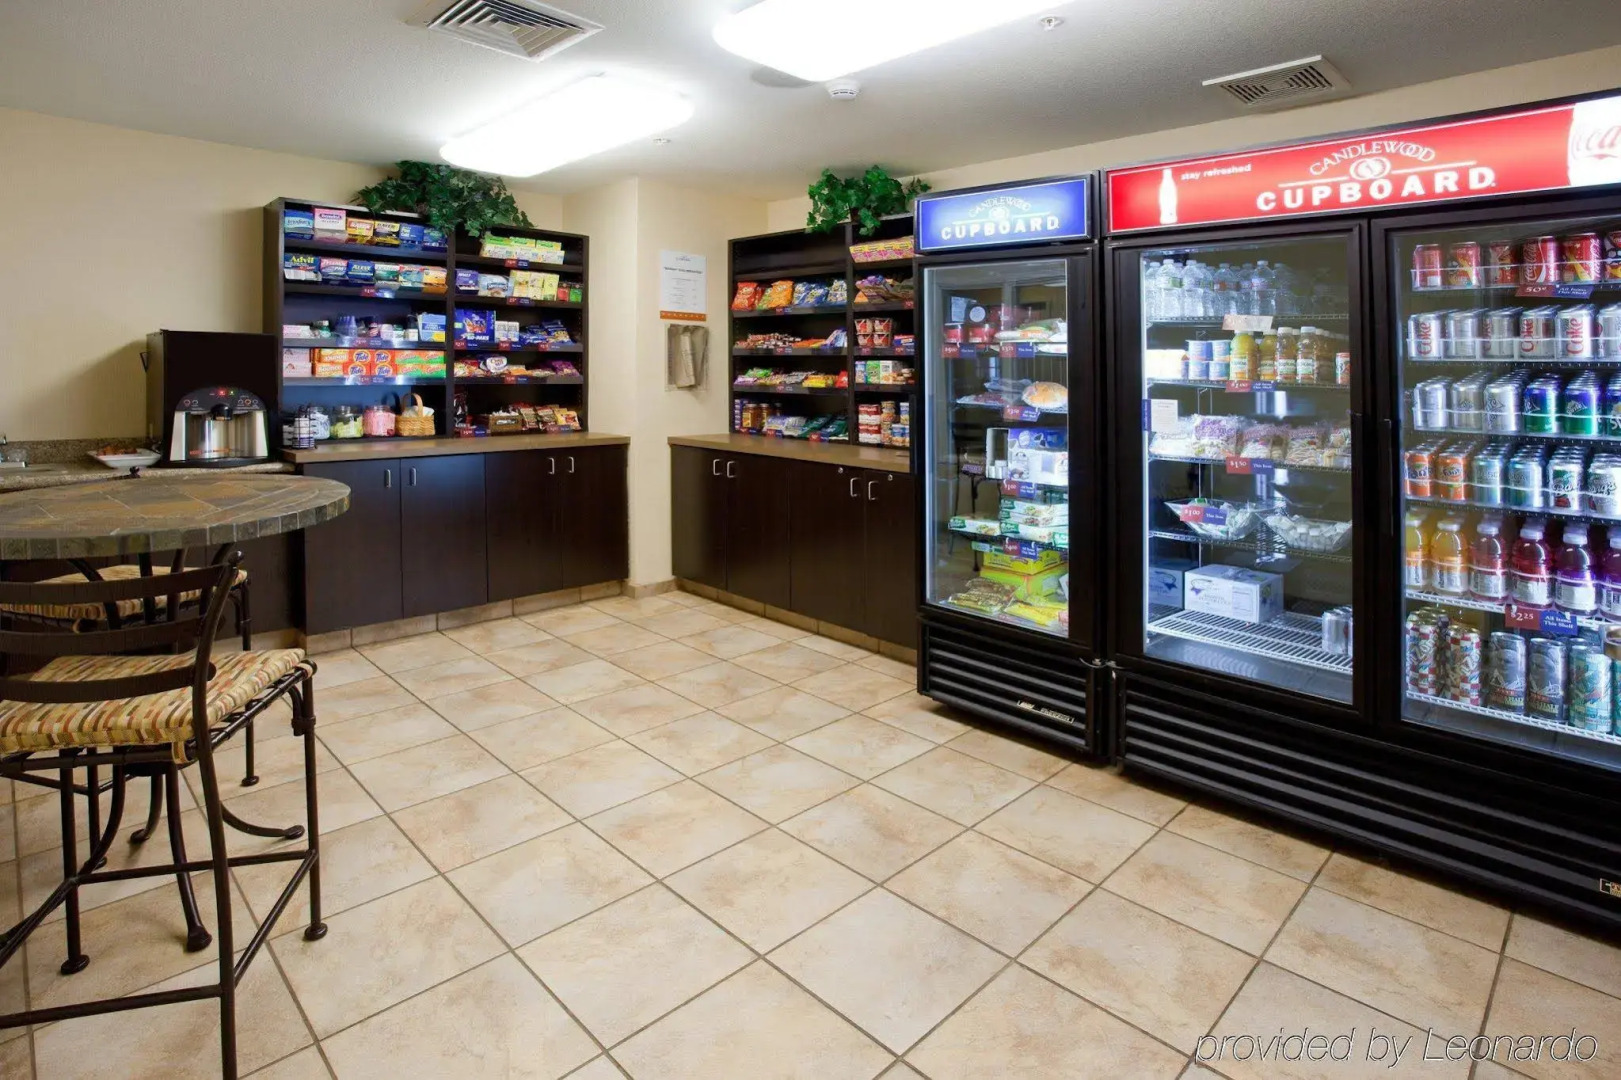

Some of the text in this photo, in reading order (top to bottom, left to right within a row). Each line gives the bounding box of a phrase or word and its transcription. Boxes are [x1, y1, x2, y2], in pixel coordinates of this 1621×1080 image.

[1309, 141, 1436, 175] CANDLEWOOD
[1181, 164, 1252, 181] stay refreshed
[1256, 167, 1494, 211] CUPBOARD
[968, 196, 1032, 218] CANDLEWOOD
[941, 215, 1059, 240] CUPBOARD
[290, 255, 315, 264] Advil
[1417, 322, 1432, 355] Coke
[1566, 317, 1584, 355] Coke
[355, 351, 369, 361] Tide
[376, 353, 389, 362] Tide
[349, 366, 363, 375] Tide
[377, 367, 391, 375] Tide
[1558, 621, 1574, 629] Shelf
